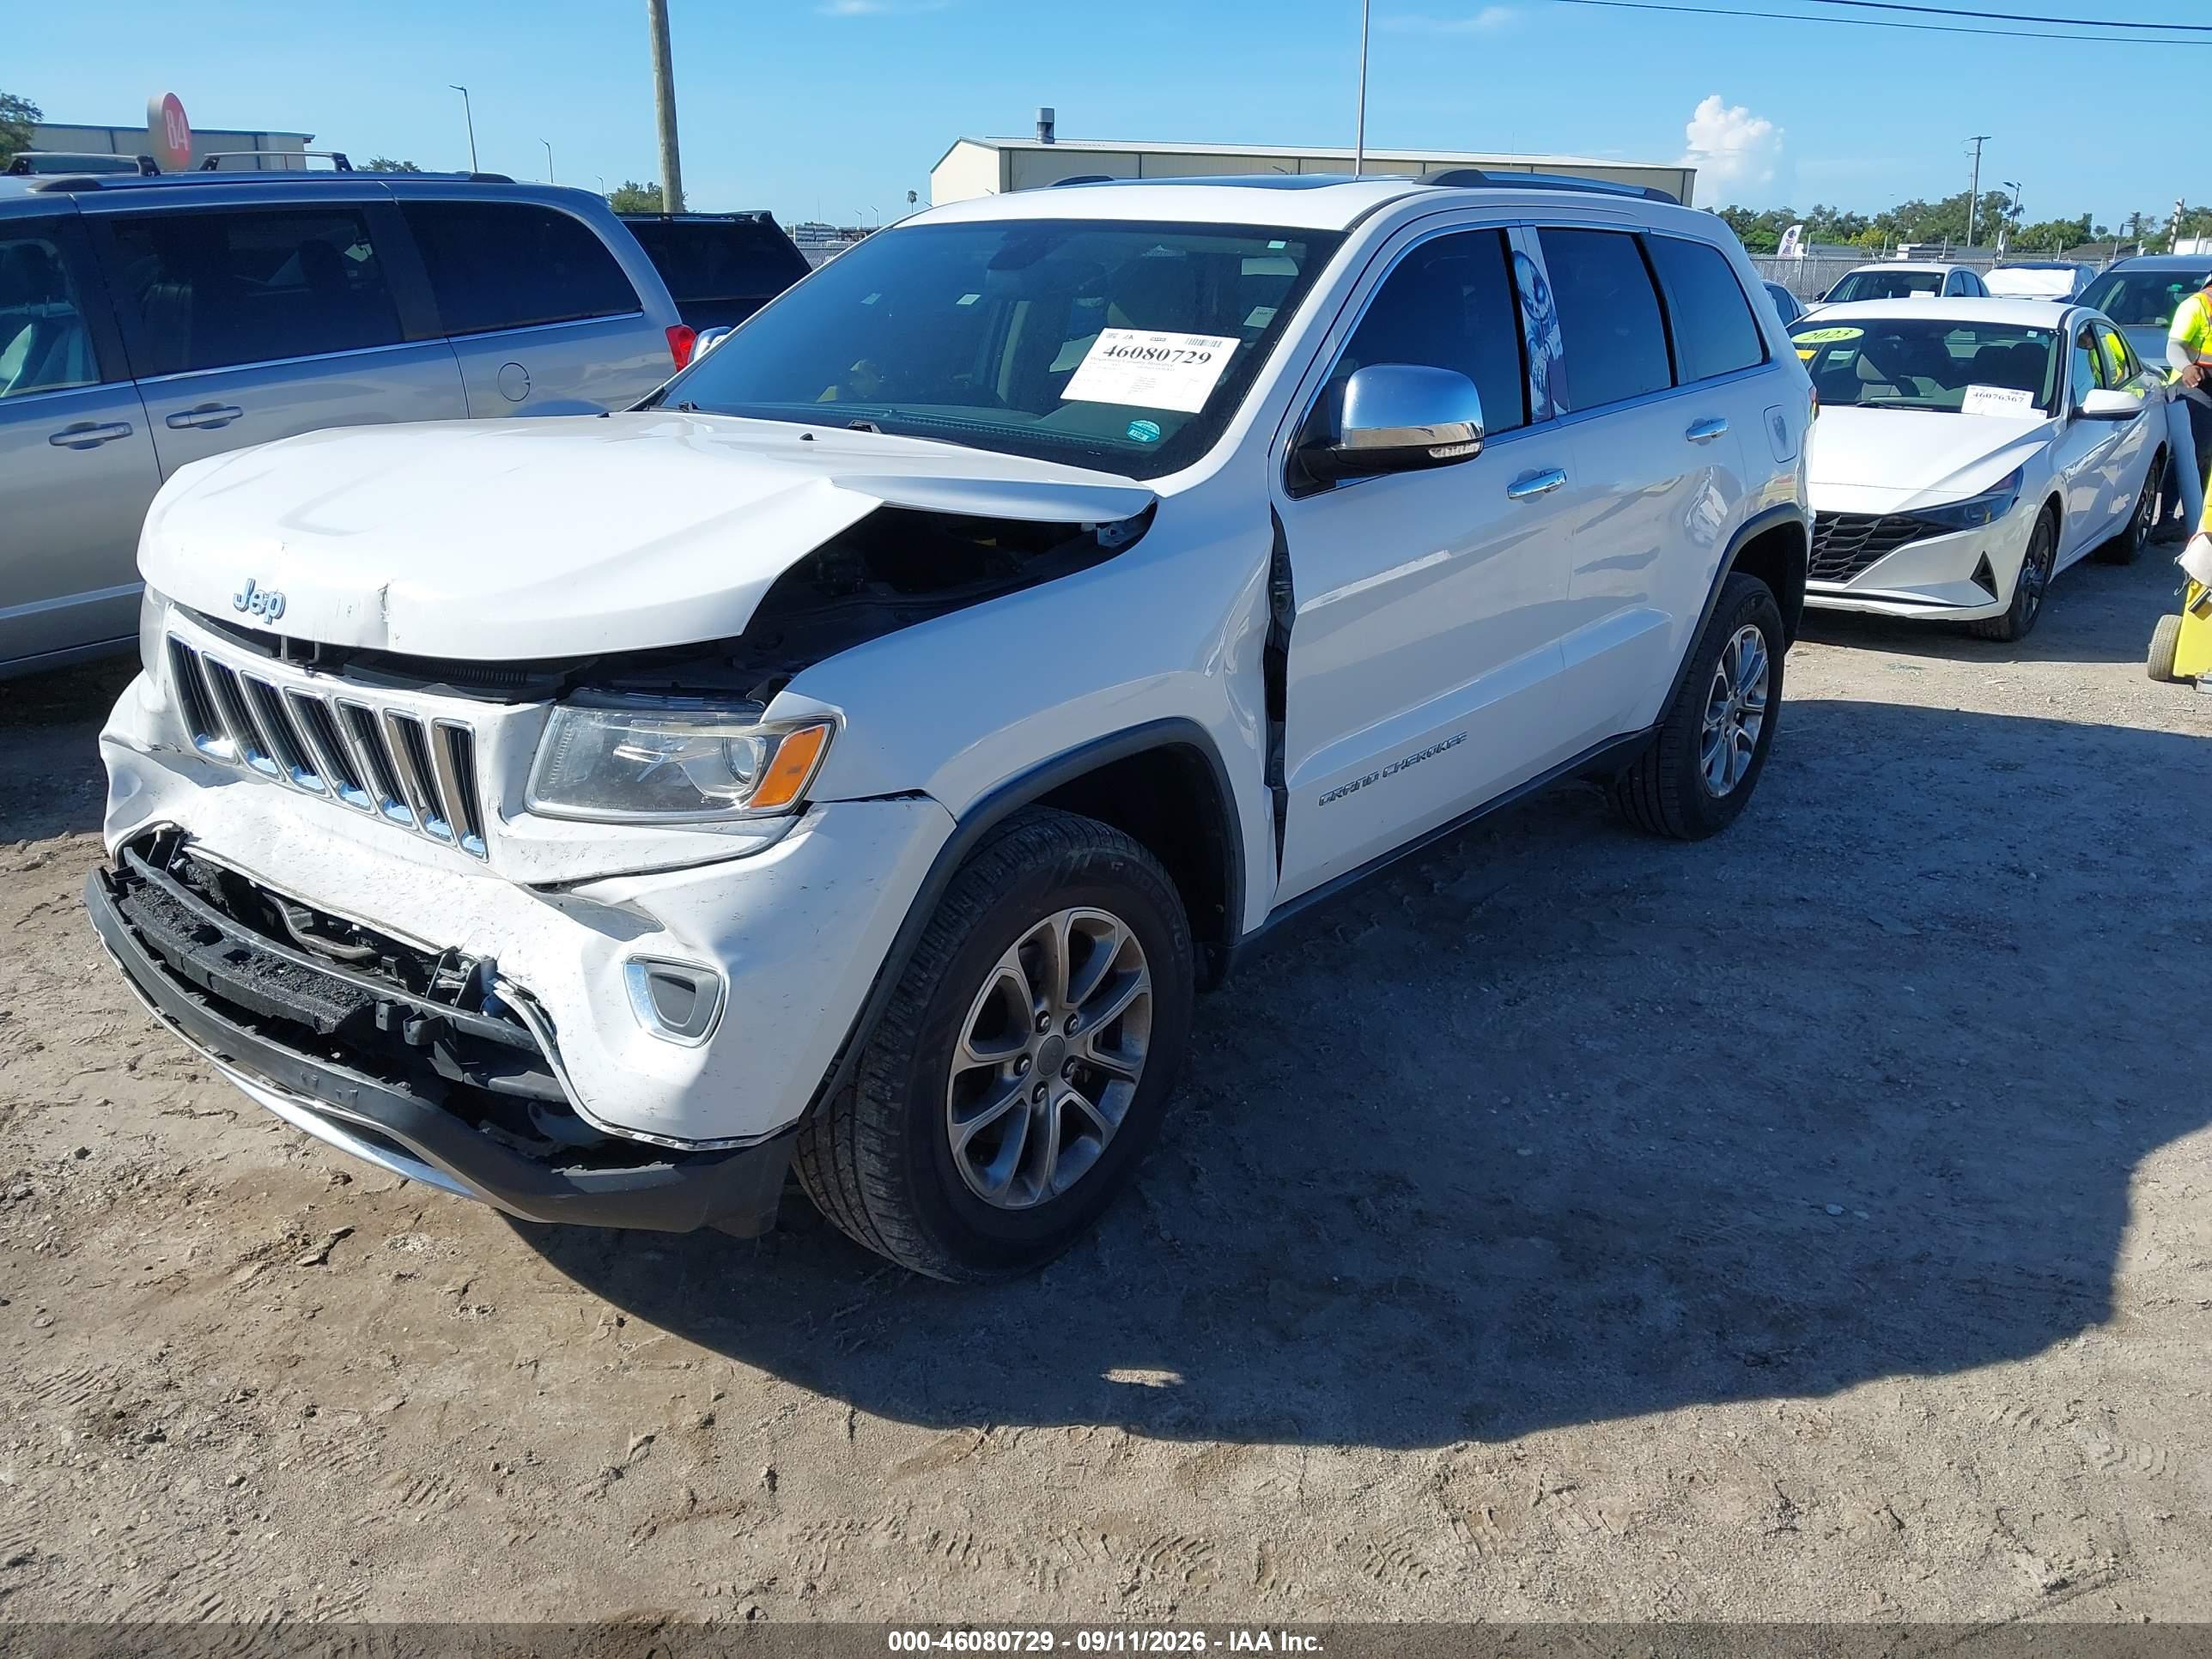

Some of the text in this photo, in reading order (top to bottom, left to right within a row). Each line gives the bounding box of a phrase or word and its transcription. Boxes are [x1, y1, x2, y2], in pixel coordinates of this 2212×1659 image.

[1802, 329, 1854, 341] 2023
[1103, 344, 1212, 365] 46080729
[1972, 392, 2025, 404] 46076367
[1319, 731, 1468, 806] GRAND CHEROKEE
